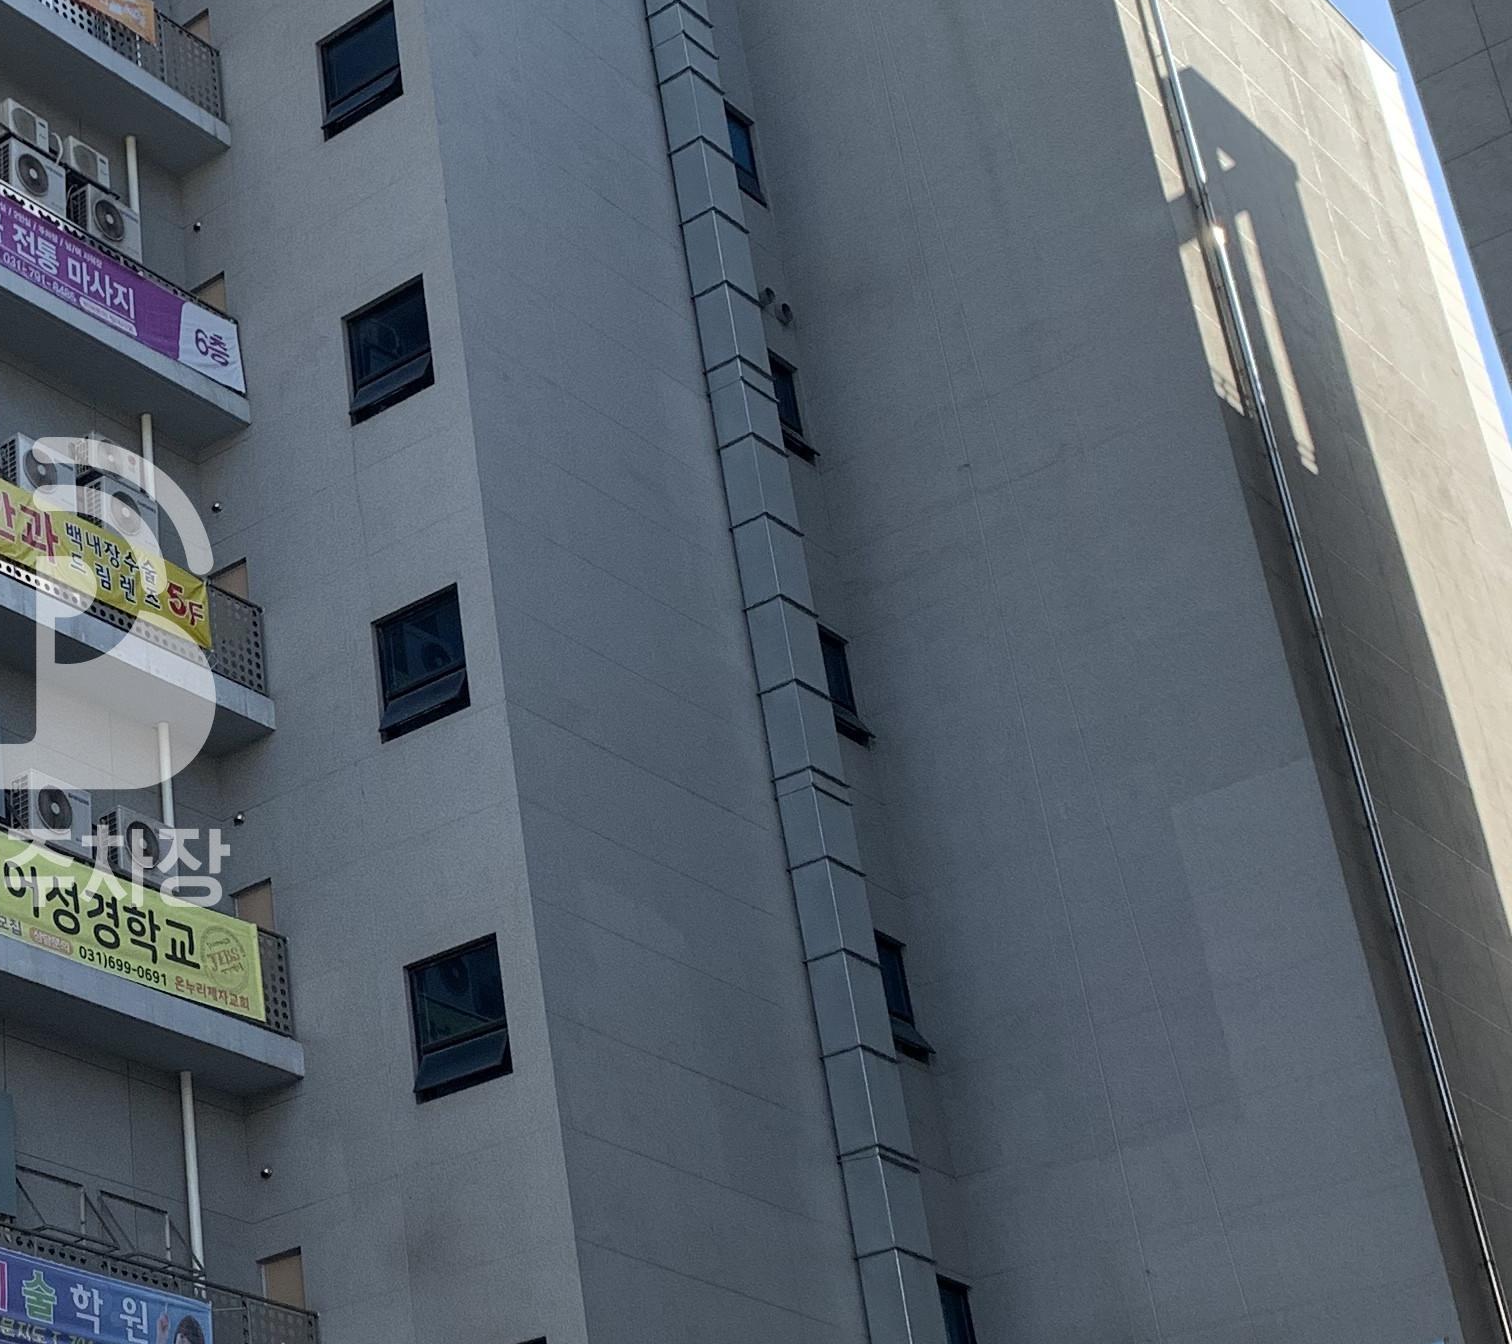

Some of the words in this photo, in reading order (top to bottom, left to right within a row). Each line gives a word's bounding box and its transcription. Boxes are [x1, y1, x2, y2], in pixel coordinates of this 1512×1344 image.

[13, 223, 60, 276] 전통
[67, 256, 136, 319] 마사지
[165, 583, 204, 627] 5F
[78, 945, 168, 987] 031)699-0691
